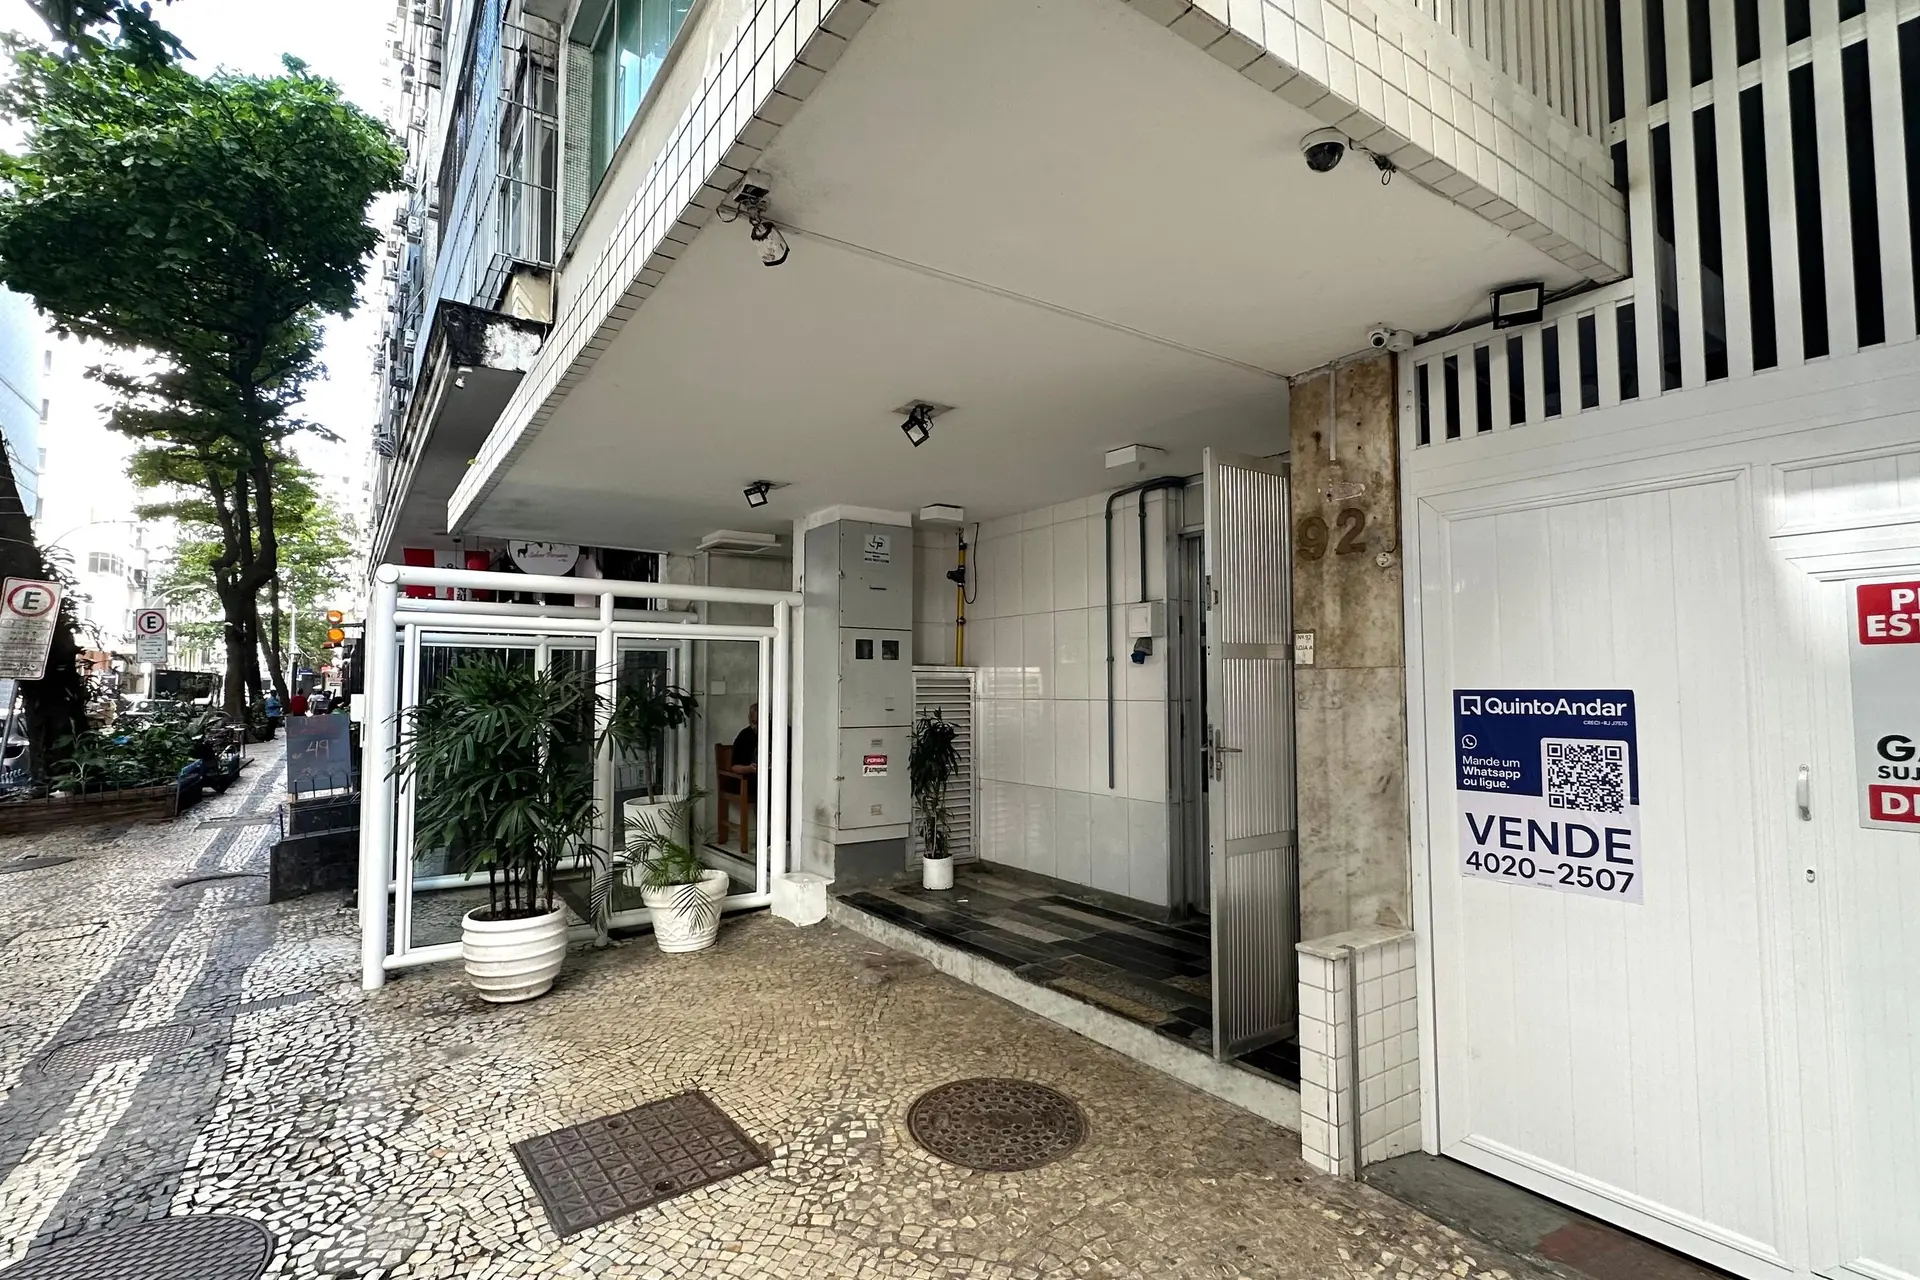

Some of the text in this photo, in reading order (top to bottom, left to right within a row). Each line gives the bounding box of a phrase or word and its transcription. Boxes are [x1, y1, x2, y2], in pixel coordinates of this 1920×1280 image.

[1296, 507, 1366, 561] 92
[22, 591, 41, 610] E
[1891, 589, 1920, 611] P
[146, 616, 157, 629] E
[1485, 697, 1627, 717] QuintoAndar
[1876, 734, 1920, 762] G
[1462, 756, 1521, 768] Mande um
[1463, 766, 1521, 780] Whatsapp
[1463, 777, 1510, 790] ou ligue.
[1465, 812, 1634, 866] VENDE
[1466, 850, 1635, 894] 4020-2507
